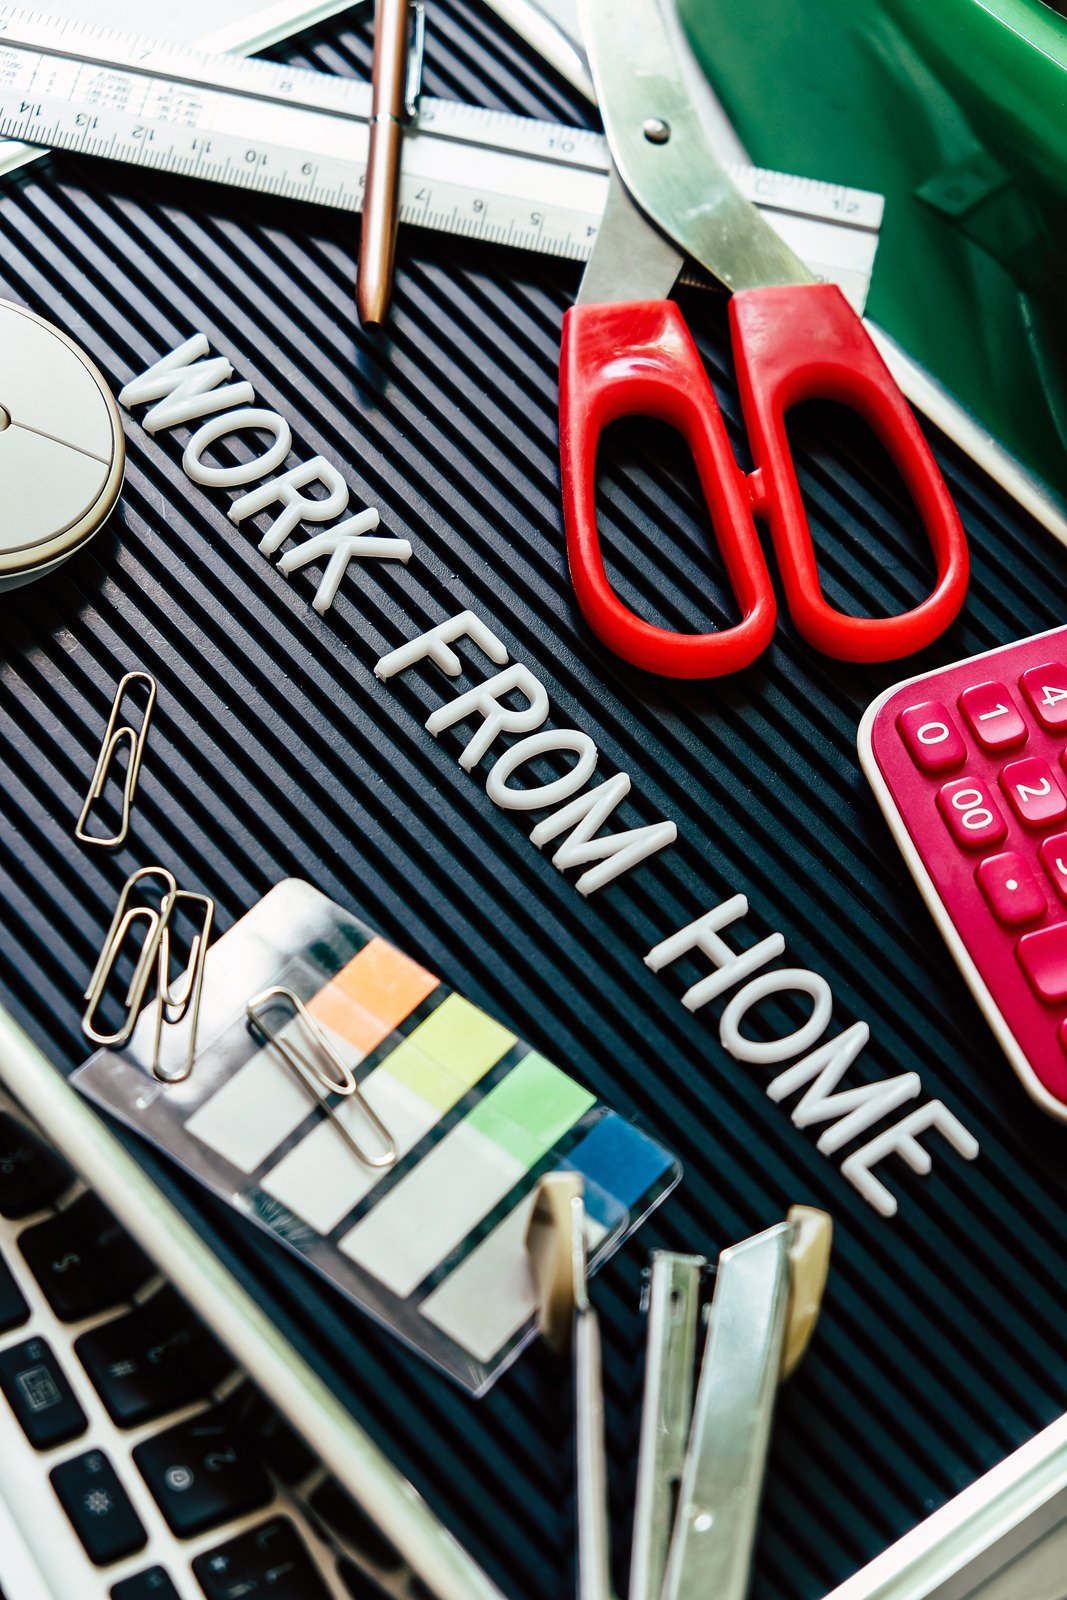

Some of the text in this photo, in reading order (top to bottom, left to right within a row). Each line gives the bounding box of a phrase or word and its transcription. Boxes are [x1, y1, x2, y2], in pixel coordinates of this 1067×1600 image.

[279, 80, 293, 94] 8
[20, 101, 42, 117] 14
[76, 113, 98, 129] 13
[132, 125, 155, 142] 12
[192, 139, 212, 153] 11
[547, 138, 576, 153] 10
[245, 150, 268, 166] 10
[301, 162, 313, 176] 9
[415, 187, 427, 201] 7
[473, 199, 484, 213] 6
[832, 199, 860, 214] 12
[530, 211, 542, 226] 5
[1041, 684, 1067, 707] 4
[979, 703, 1009, 722] 1
[917, 722, 949, 745] 0
[119, 333, 979, 1217] WORK FROM HOME
[1016, 777, 1051, 803] 2
[951, 788, 993, 830] 00
